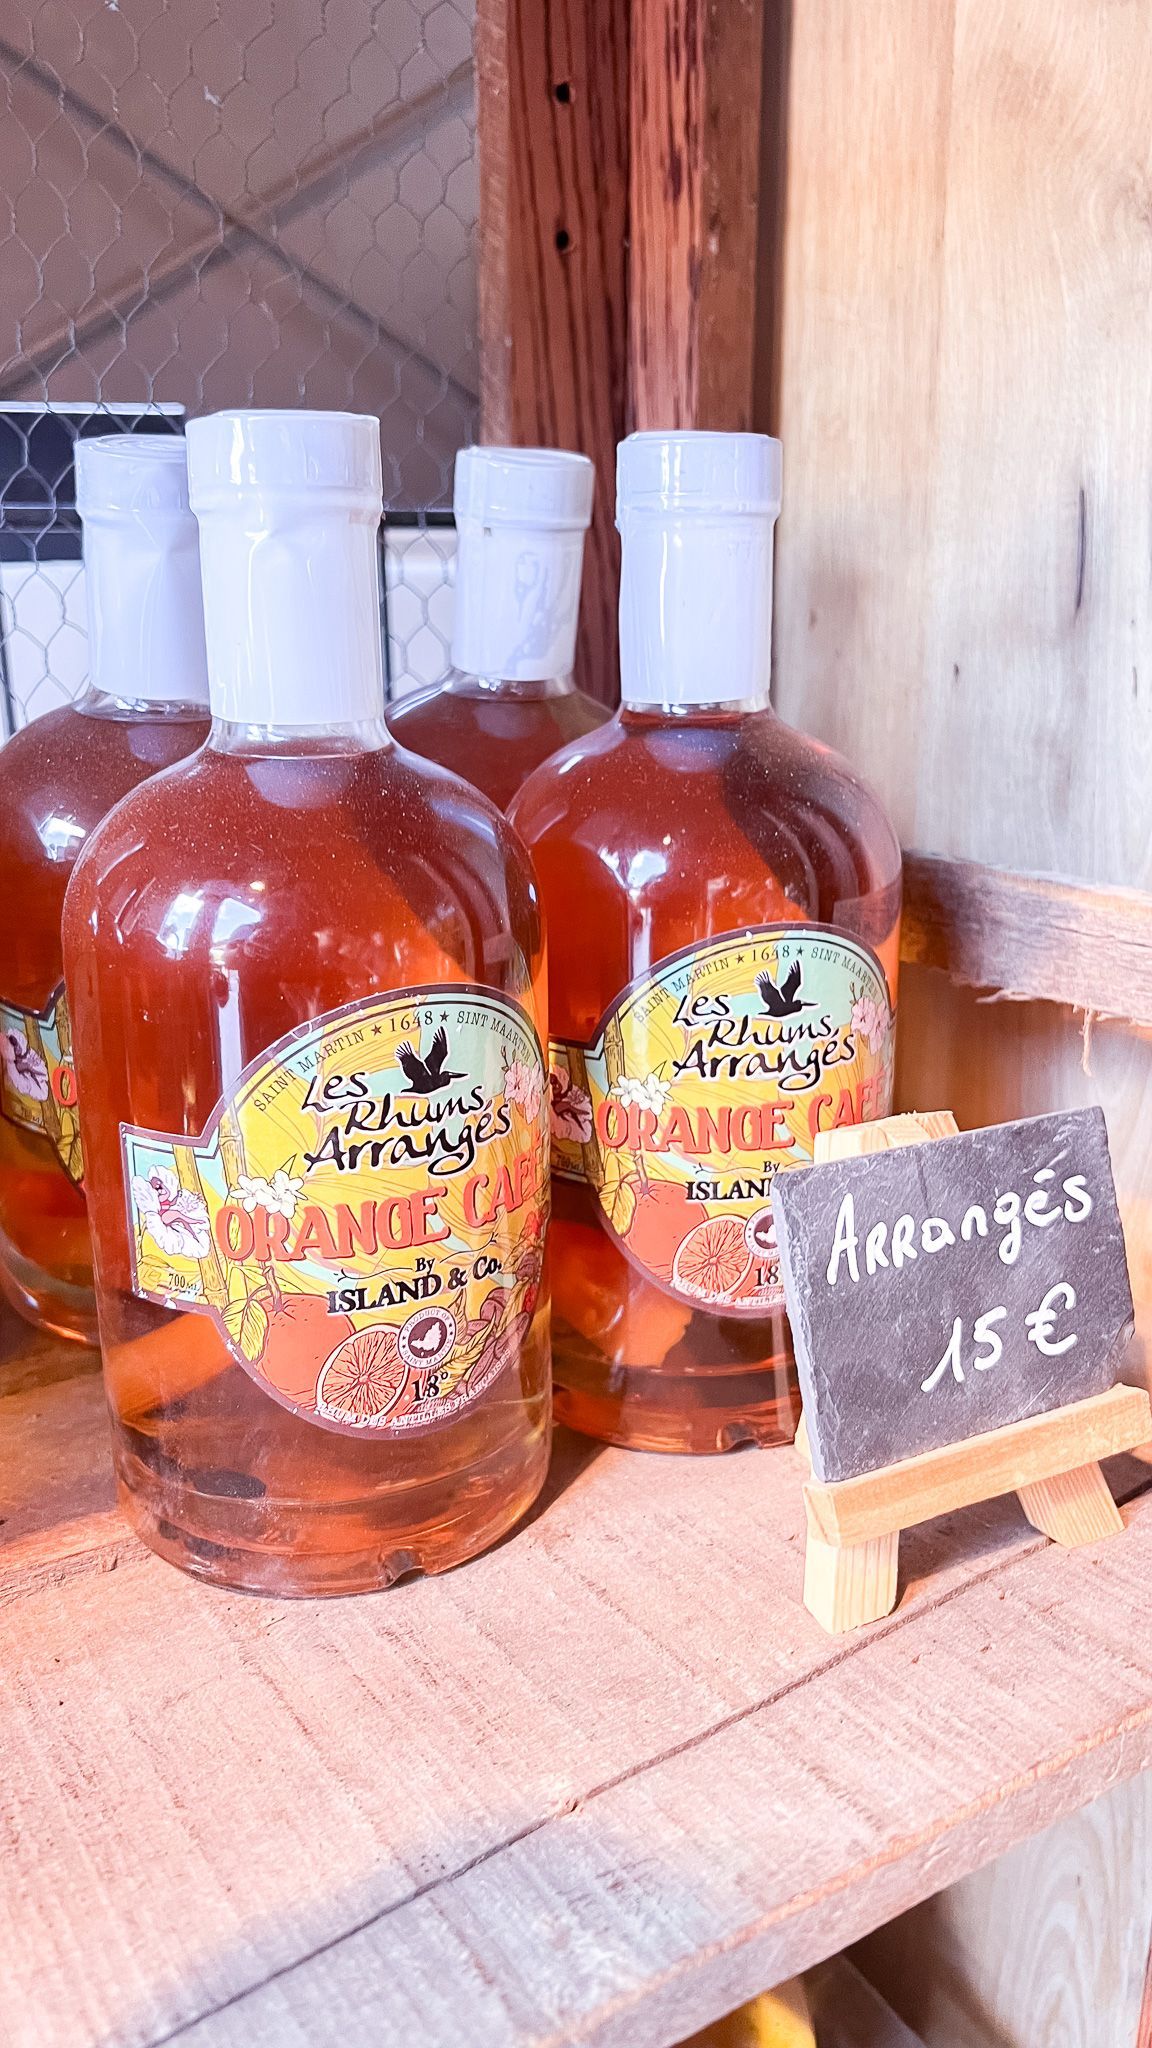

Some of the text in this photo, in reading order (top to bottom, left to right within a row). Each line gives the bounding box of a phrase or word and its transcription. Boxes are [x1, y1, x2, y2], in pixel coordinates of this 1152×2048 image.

[633, 986, 671, 1022] SAINT
[672, 957, 729, 992] MARTIN
[752, 944, 790, 961] 1648
[811, 946, 841, 964] SINT
[672, 993, 731, 1026] Les
[704, 1015, 832, 1047] Rhums
[253, 1010, 532, 1112] SAINT MARTIN 1648 SINT MAARTEN
[672, 1028, 856, 1091] Arrangés
[301, 1071, 369, 1112] Les
[339, 1085, 484, 1135] Rhums
[303, 1099, 511, 1176] Arrangés
[595, 1100, 796, 1154] ORANGE
[762, 1160, 780, 1174] By
[215, 1186, 451, 1262] ORANGE
[326, 1255, 502, 1314] ISLAND & Co.
[415, 1256, 435, 1274] By
[404, 1308, 441, 1333] PRODUCT
[411, 1371, 449, 1402] 18°
